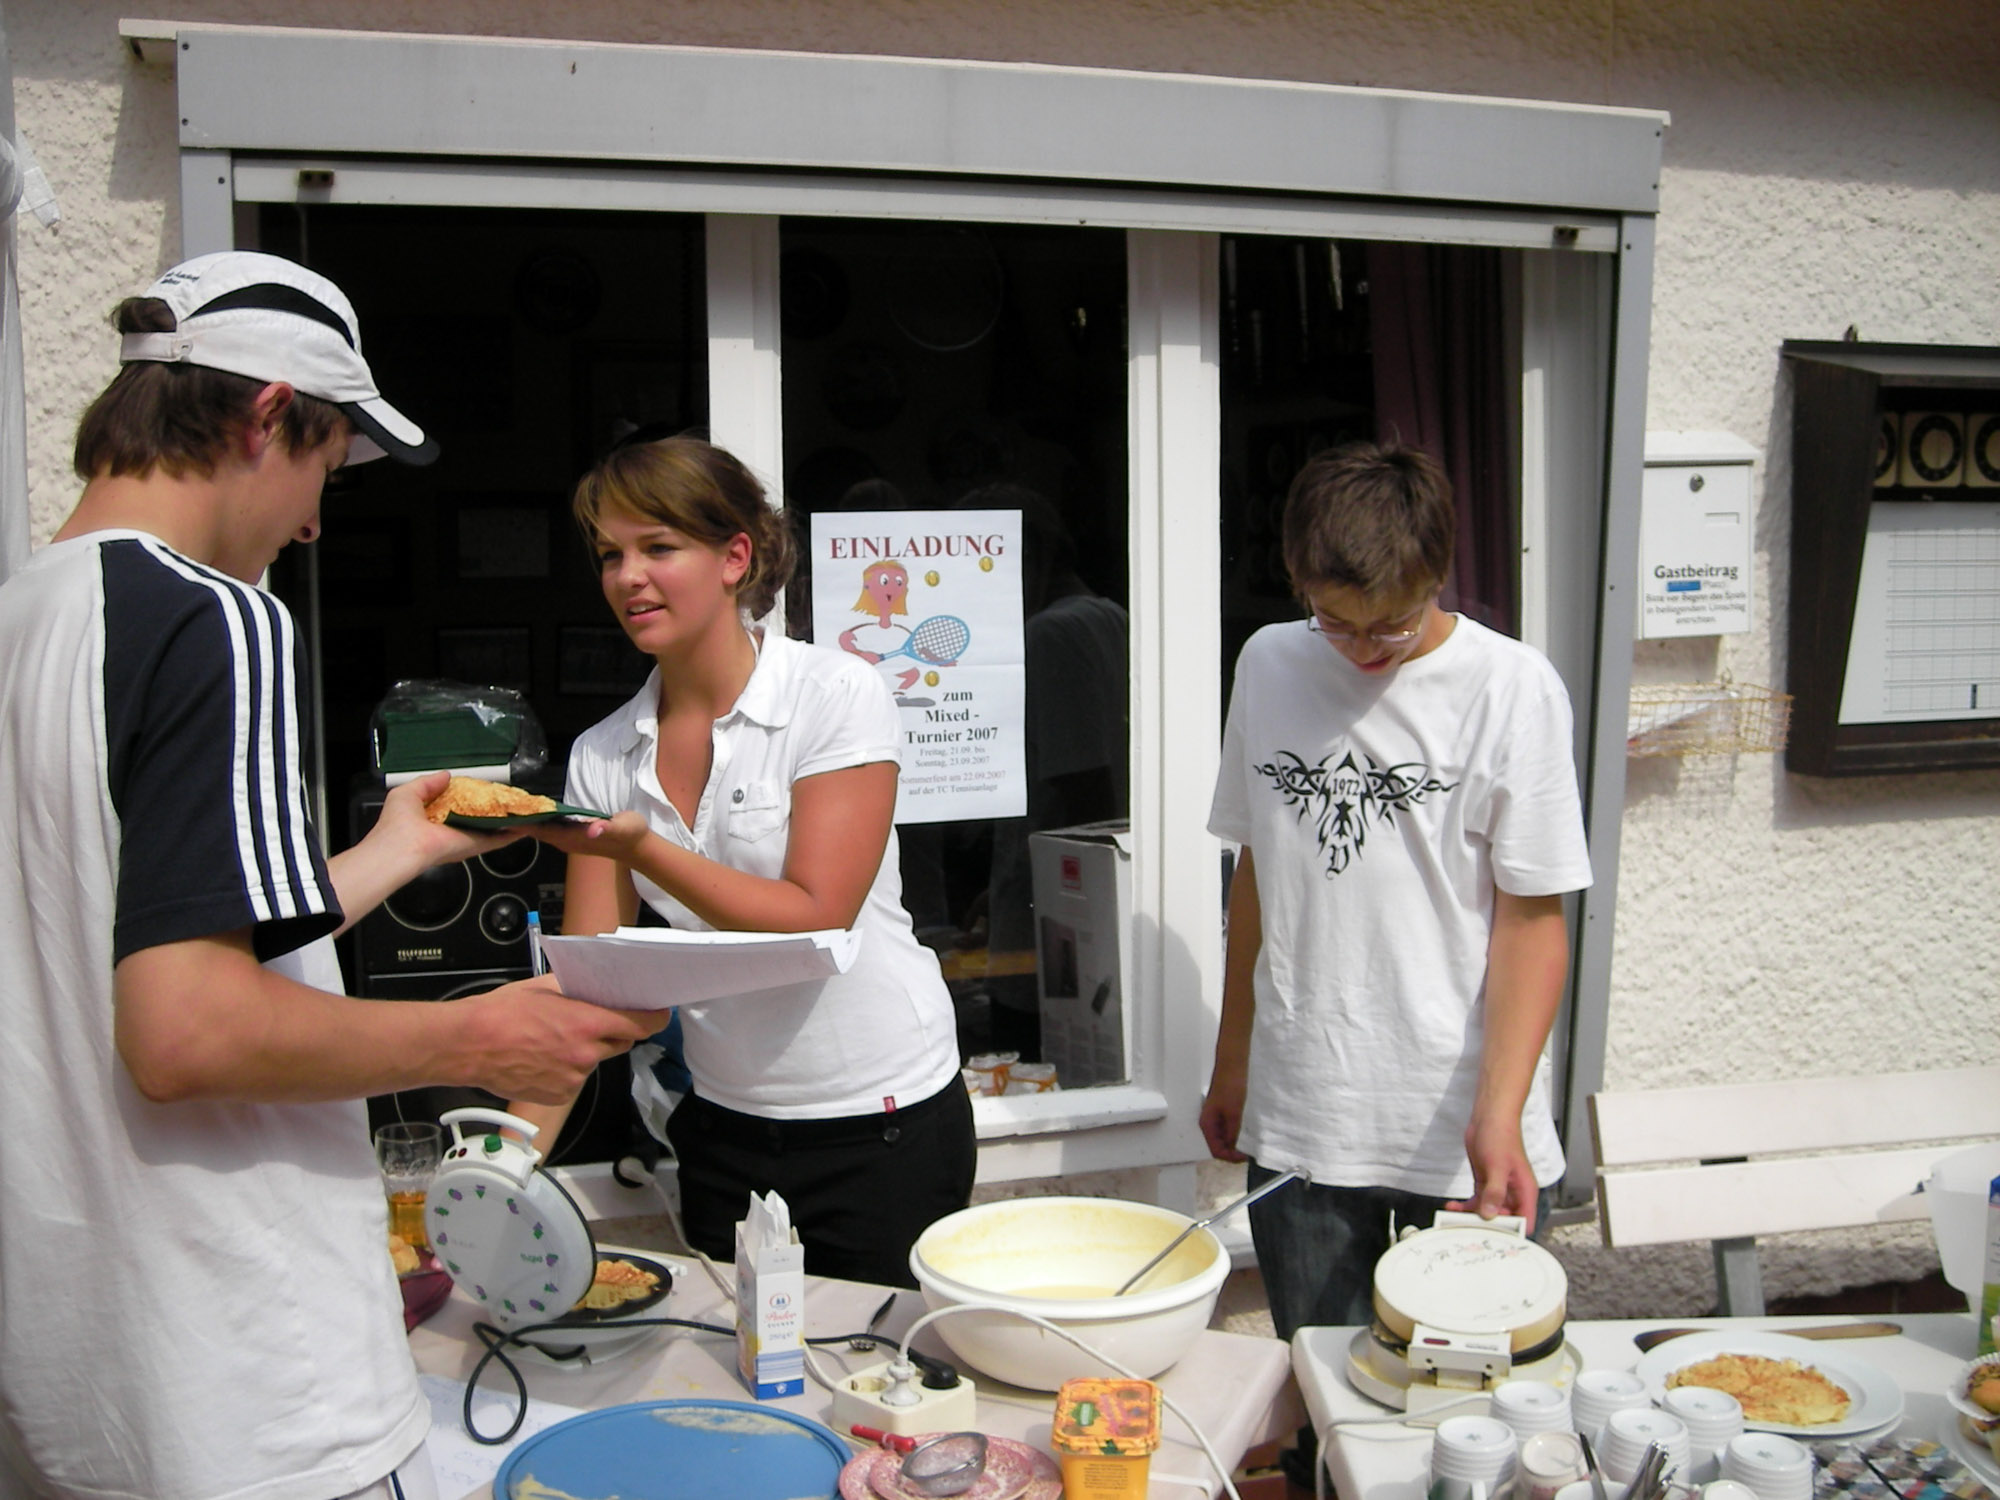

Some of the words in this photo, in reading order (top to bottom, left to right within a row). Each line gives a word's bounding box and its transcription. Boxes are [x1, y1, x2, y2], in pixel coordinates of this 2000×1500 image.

[829, 534, 1005, 559] EINLADUNG
[1653, 563, 1738, 580] Gastbeitrag
[943, 690, 973, 702] zum
[925, 708, 969, 723] Mixed
[905, 729, 962, 744] Turnier
[966, 726, 998, 741] 2007
[974, 744, 986, 753] bis
[922, 786, 935, 794] der
[1331, 778, 1360, 796] 1972
